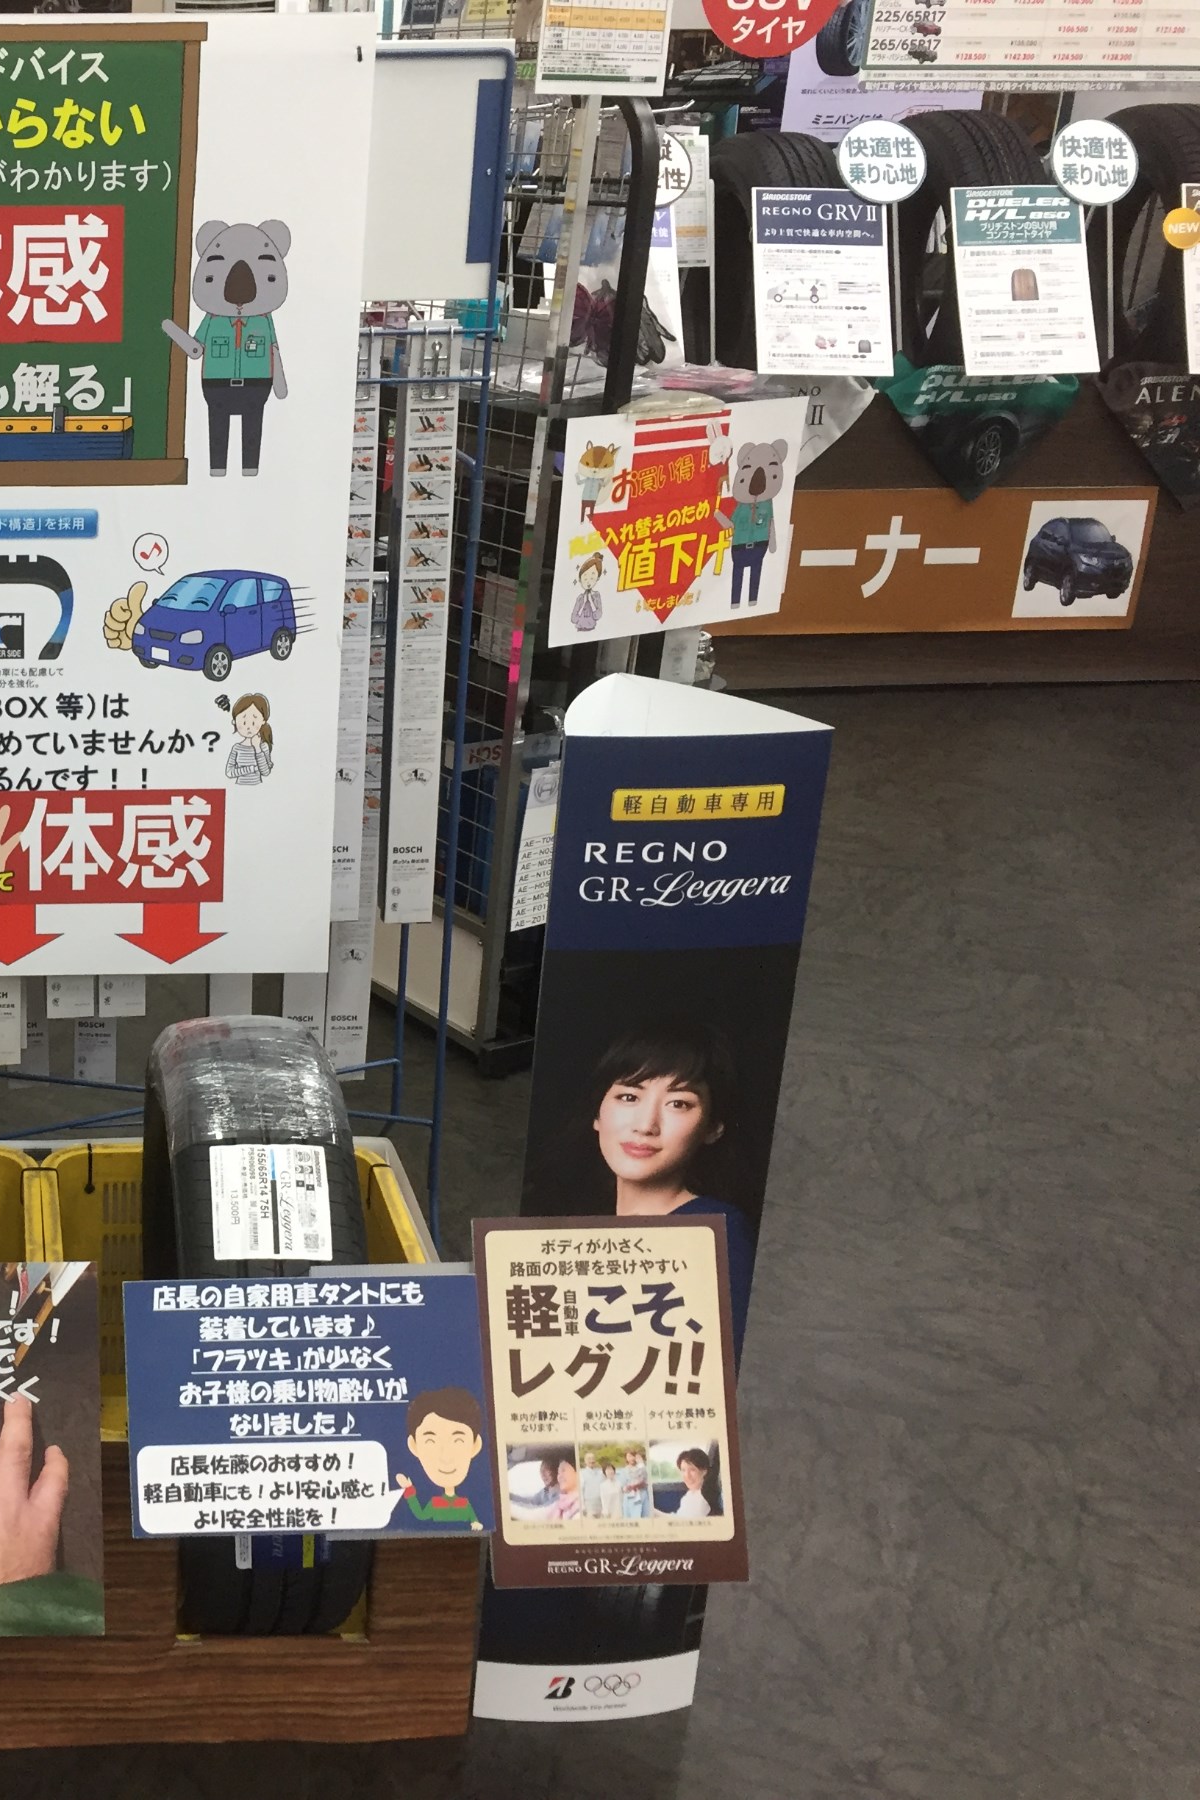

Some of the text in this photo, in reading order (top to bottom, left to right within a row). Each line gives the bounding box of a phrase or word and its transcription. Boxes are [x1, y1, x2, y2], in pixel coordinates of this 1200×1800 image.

[732, 16, 806, 44] タイヤ
[845, 136, 917, 158] 快適性
[1059, 136, 1129, 160] 快適性
[848, 162, 918, 185] 乗り心地
[1061, 164, 1130, 187] 乗り心地
[762, 193, 812, 201] BRIDGESTONE
[966, 197, 1071, 209] DUELER
[762, 206, 812, 216] REGNO
[965, 209, 1027, 222] H/L
[1168, 222, 1200, 234] NEW
[617, 528, 735, 592] 値下げ
[7, 649, 22, 659] SIDE
[622, 790, 775, 816] 軽自動車専用
[19, 795, 212, 892] 体感
[393, 846, 423, 854] BOSCH
[584, 840, 728, 864] REGNO
[578, 870, 792, 907] GR-Leggera
[78, 1021, 105, 1029] BOSCH
[257, 1148, 269, 1197] 155/65R14
[540, 1238, 653, 1255] ボディが小さく、
[509, 1258, 688, 1277] 路面の影響を受けやすい
[153, 1281, 424, 1309] 店長の自家用車タントにも
[192, 1345, 394, 1372] 「フラツキ」が少なく
[508, 1341, 705, 1399] レグノ!!
[179, 1377, 408, 1405] お子様の乗り物酔いが
[510, 1407, 716, 1422] 車内が静かに 乗り心地が タイヤが長持ち
[170, 1451, 355, 1476] 店長佐藤のおすすめ！
[143, 1479, 387, 1504] 軽自動車にも！より安心感と！
[193, 1508, 338, 1529] より安全性能を！
[584, 1555, 695, 1577] GR-Leggera
